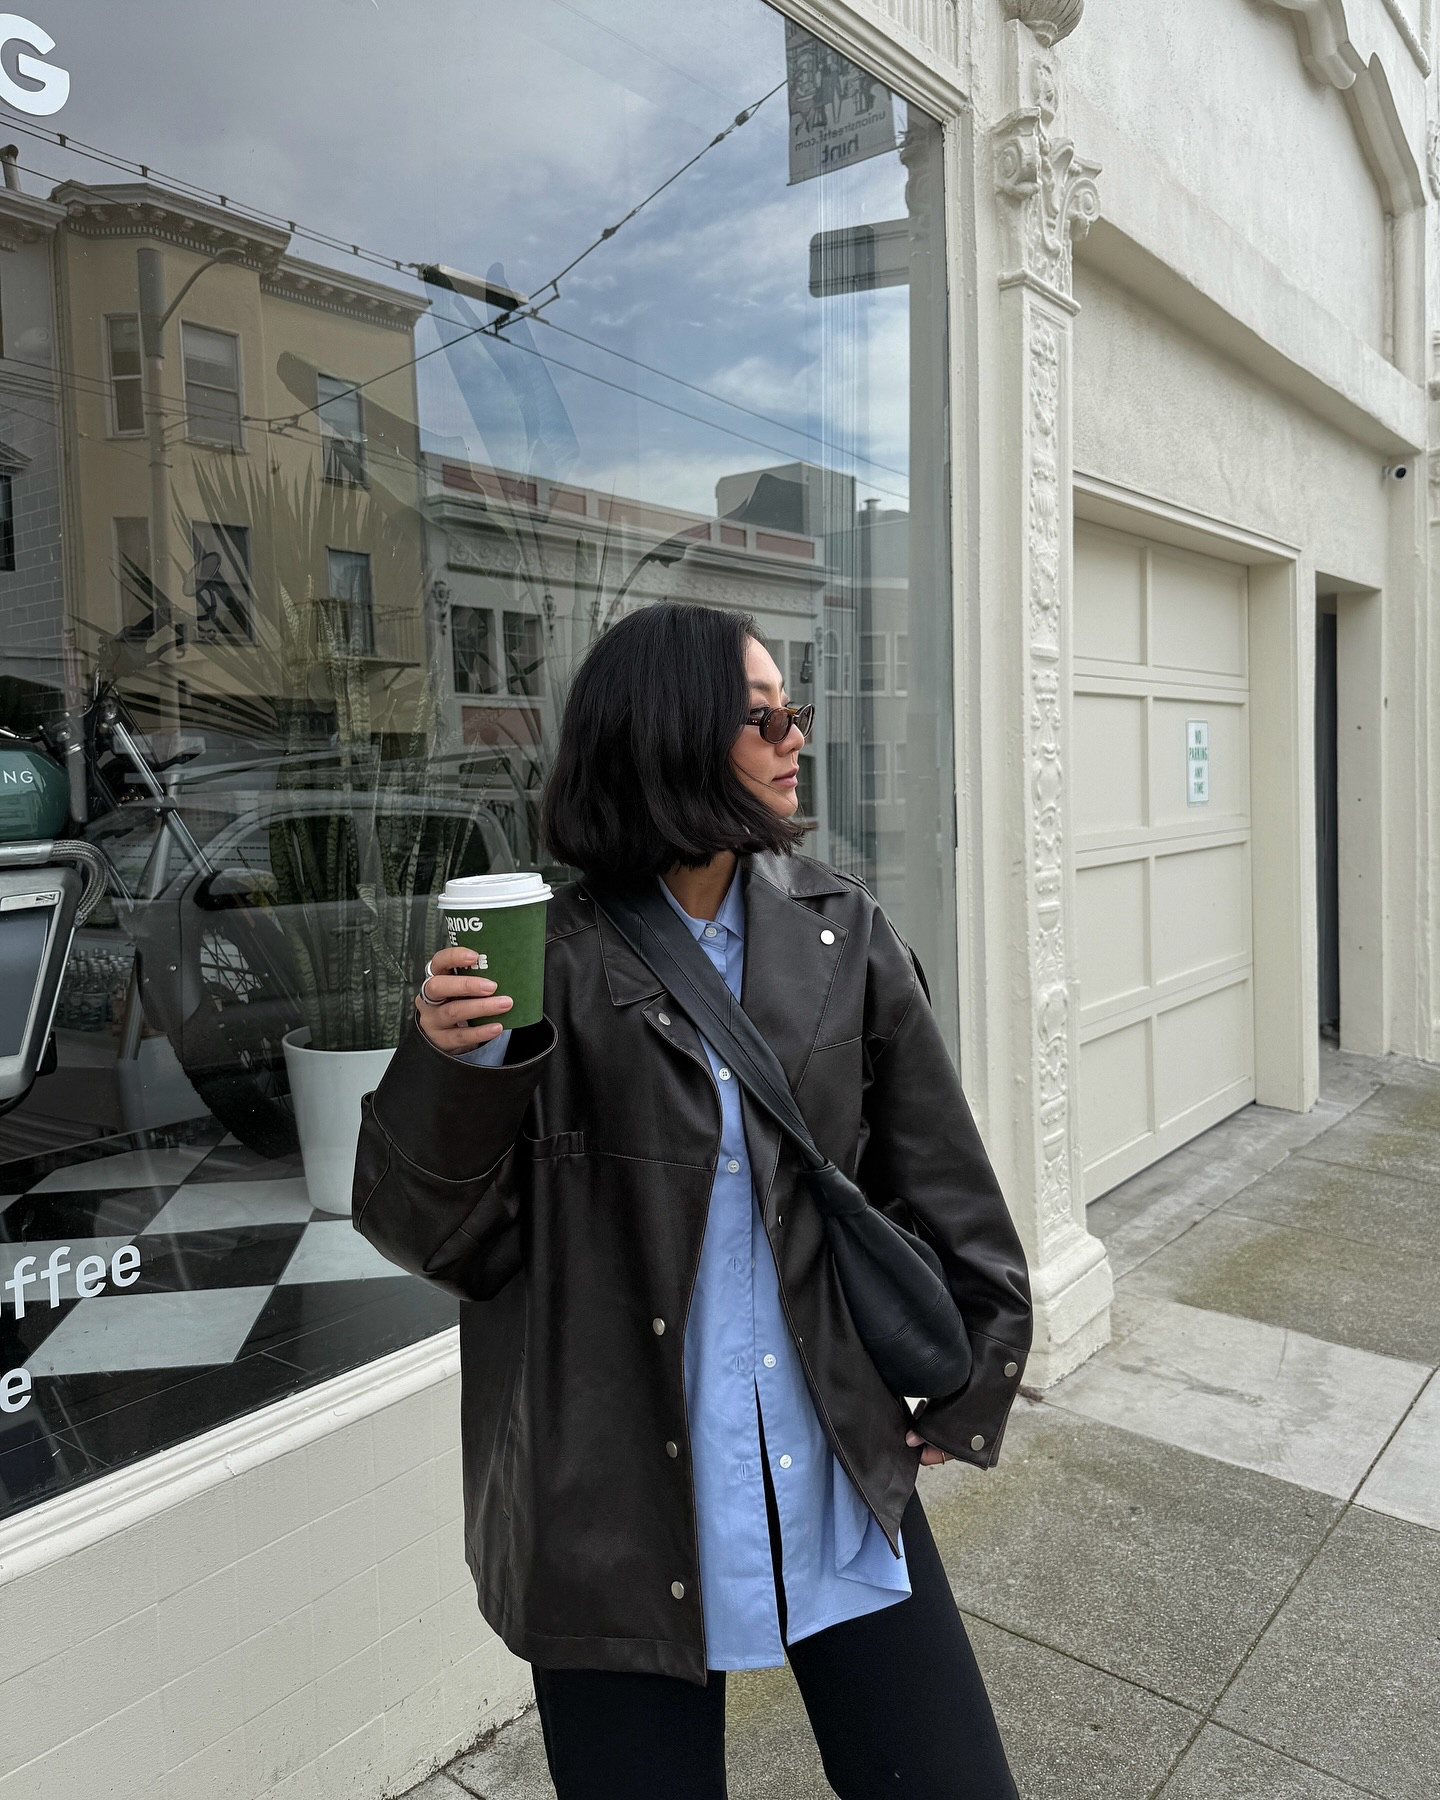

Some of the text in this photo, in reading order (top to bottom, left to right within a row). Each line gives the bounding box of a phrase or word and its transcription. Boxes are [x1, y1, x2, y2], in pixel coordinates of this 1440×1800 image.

[1194, 730, 1202, 745] NO
[1188, 746, 1208, 761] PARKING
[2, 769, 34, 784] NG
[445, 915, 483, 932] RING
[0, 1244, 142, 1320] ffee
